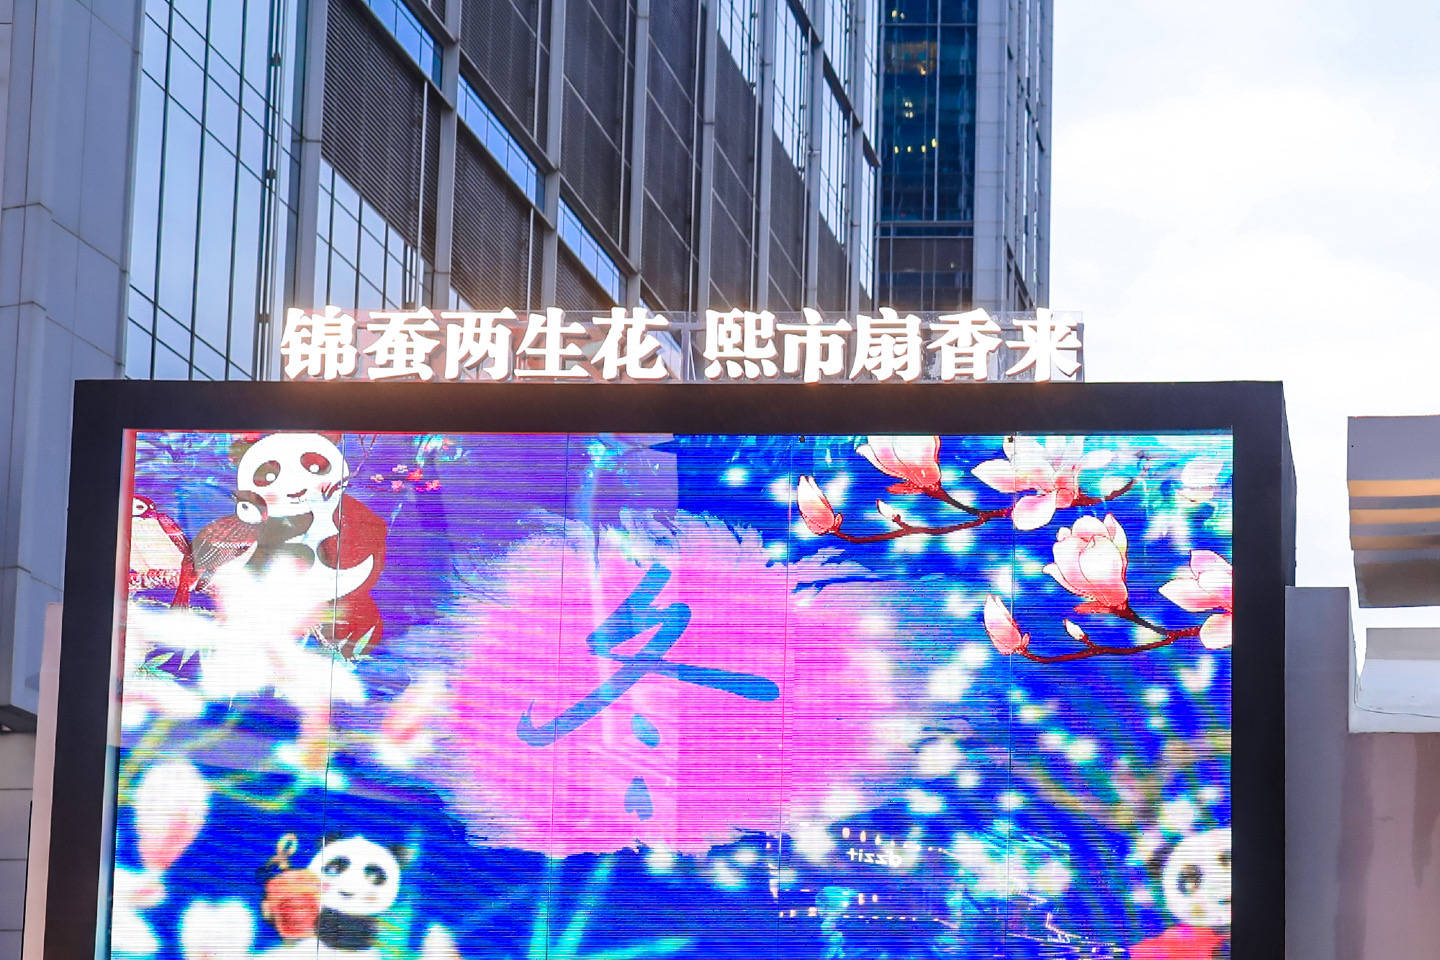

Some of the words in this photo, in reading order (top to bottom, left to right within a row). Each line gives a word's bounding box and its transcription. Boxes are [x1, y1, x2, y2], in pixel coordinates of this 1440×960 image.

[280, 305, 672, 382] 锦蚕两生花
[703, 306, 1083, 384] 熙市扇香来
